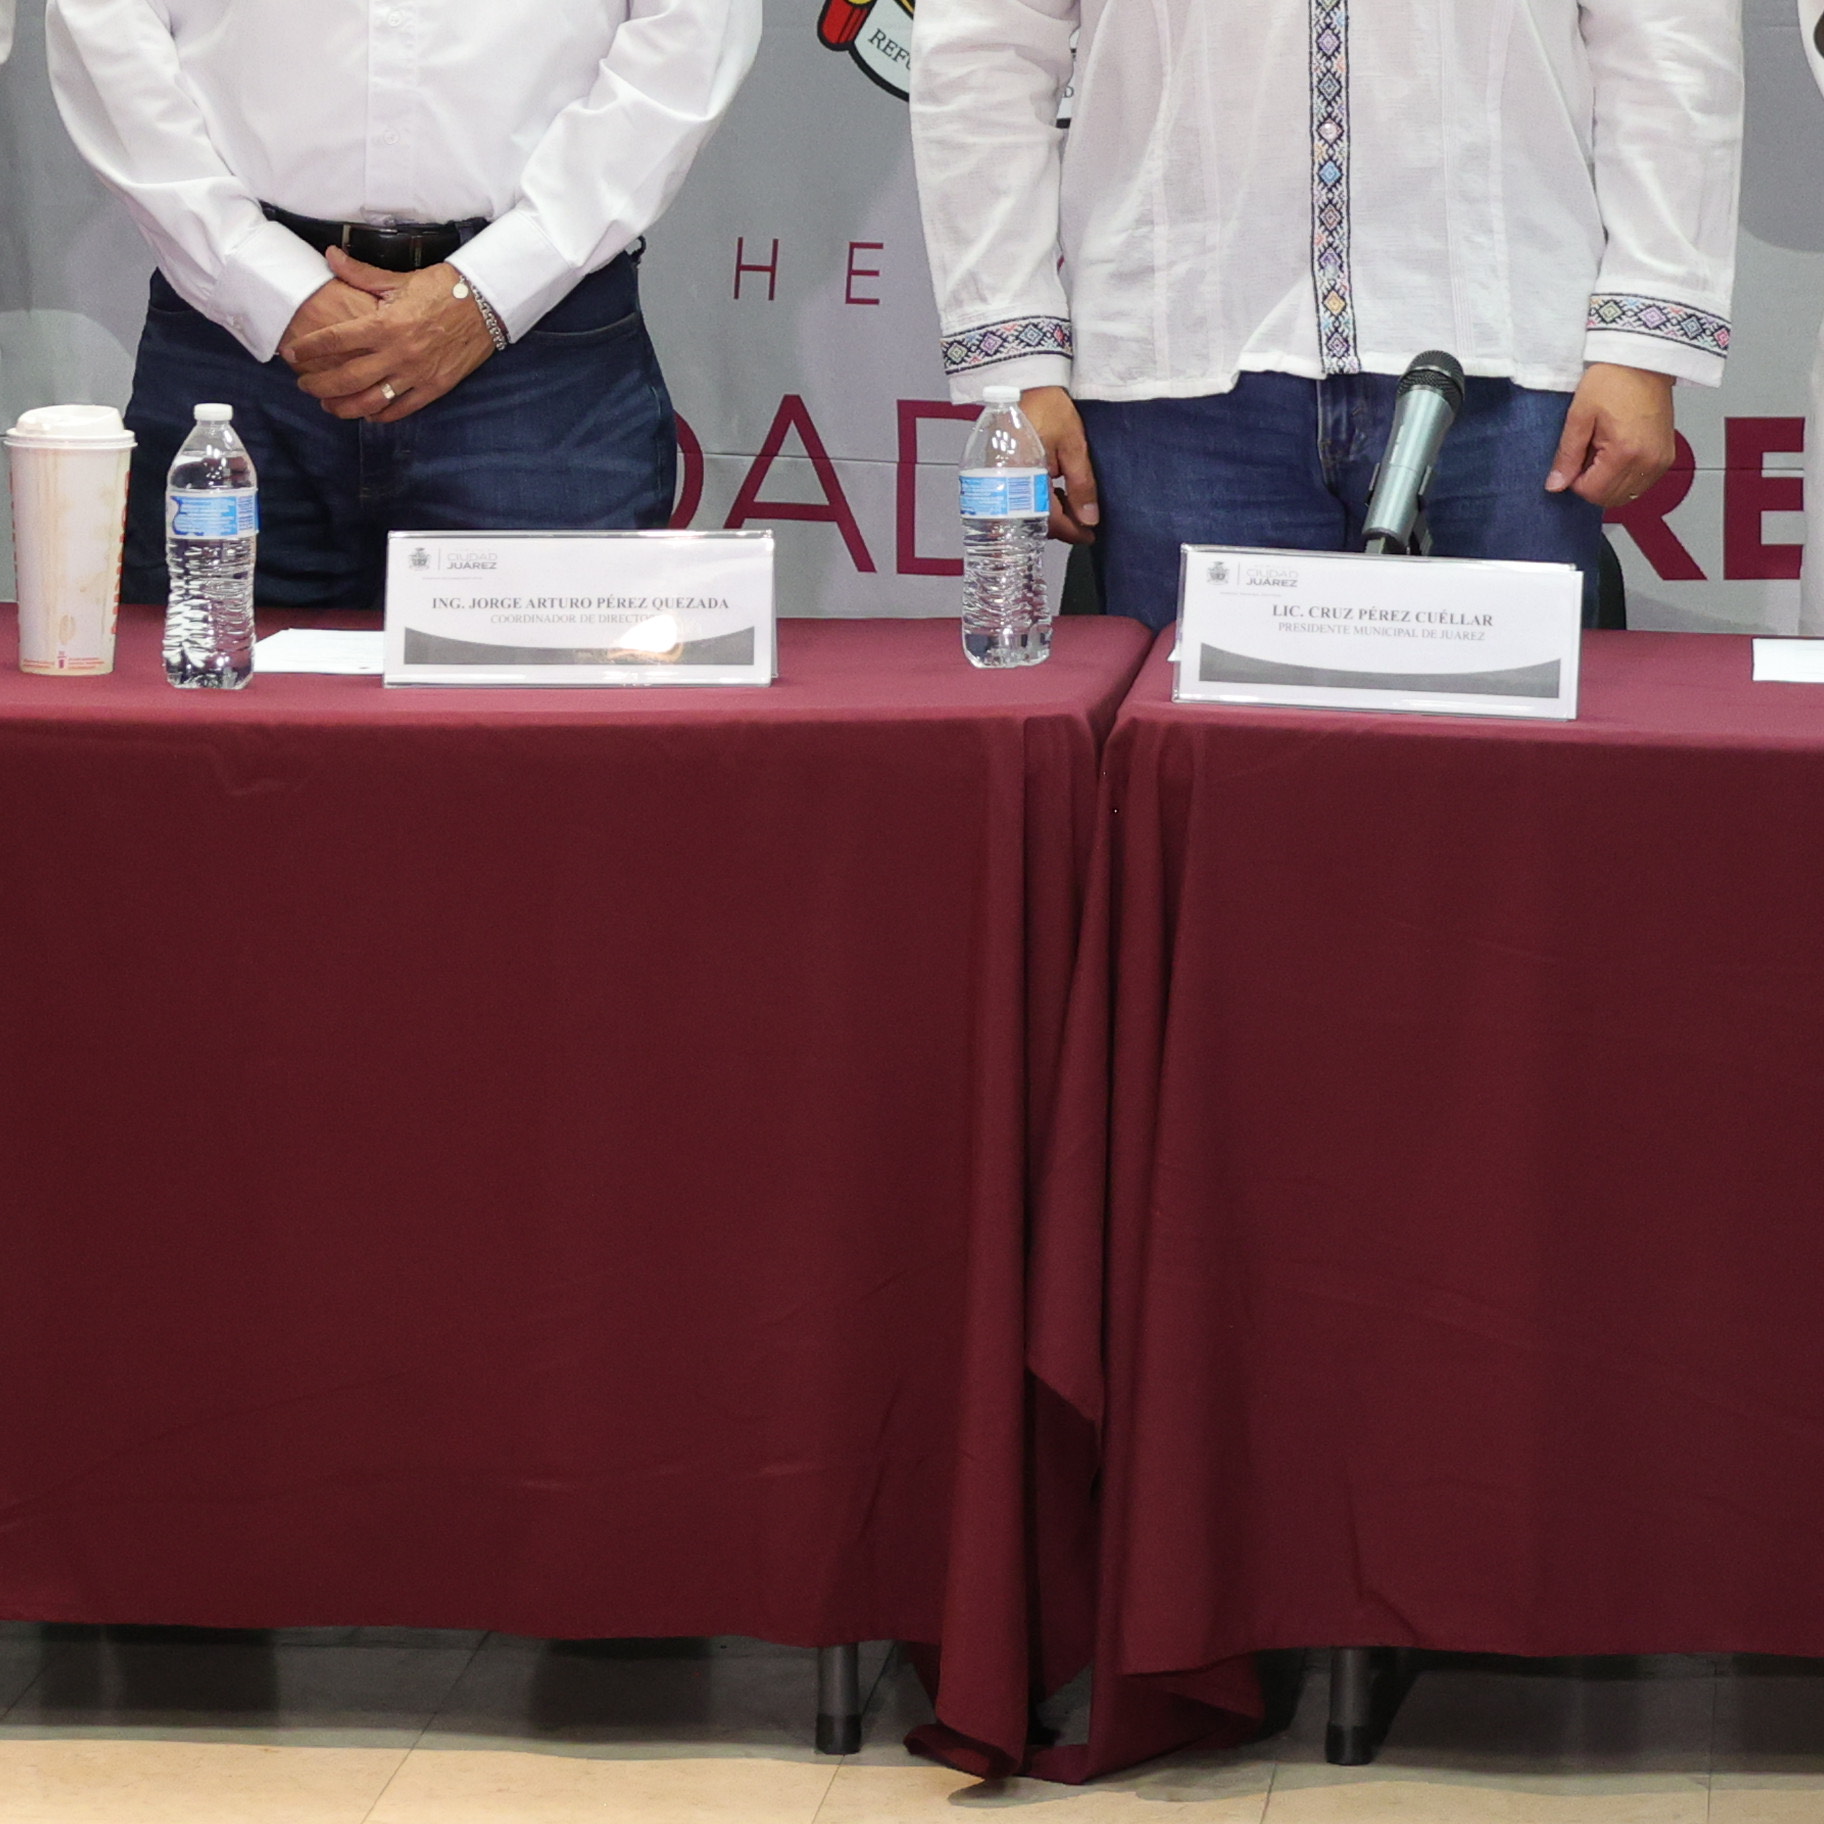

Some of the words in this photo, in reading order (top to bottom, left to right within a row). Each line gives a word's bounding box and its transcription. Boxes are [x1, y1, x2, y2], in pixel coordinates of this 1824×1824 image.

[446, 561, 498, 571] JUÁREZ
[1245, 575, 1299, 589] JUÁREZ
[430, 596, 468, 611] ING.
[469, 596, 524, 611] JORGE
[525, 596, 594, 611] ARTURO
[595, 593, 649, 611] PÉREZ
[651, 596, 730, 612] QUEZADA
[489, 613, 577, 625] COORDINADOR
[578, 613, 596, 625] DE
[1272, 604, 1305, 619] LIC.
[1308, 606, 1355, 621] CRUZ
[1358, 605, 1412, 624] PÉREZ
[1414, 609, 1495, 627] CUÉLLAR
[1277, 621, 1352, 637] PRESIDENTE
[1352, 624, 1420, 640] MUNICIPAL
[1420, 628, 1439, 640] DE
